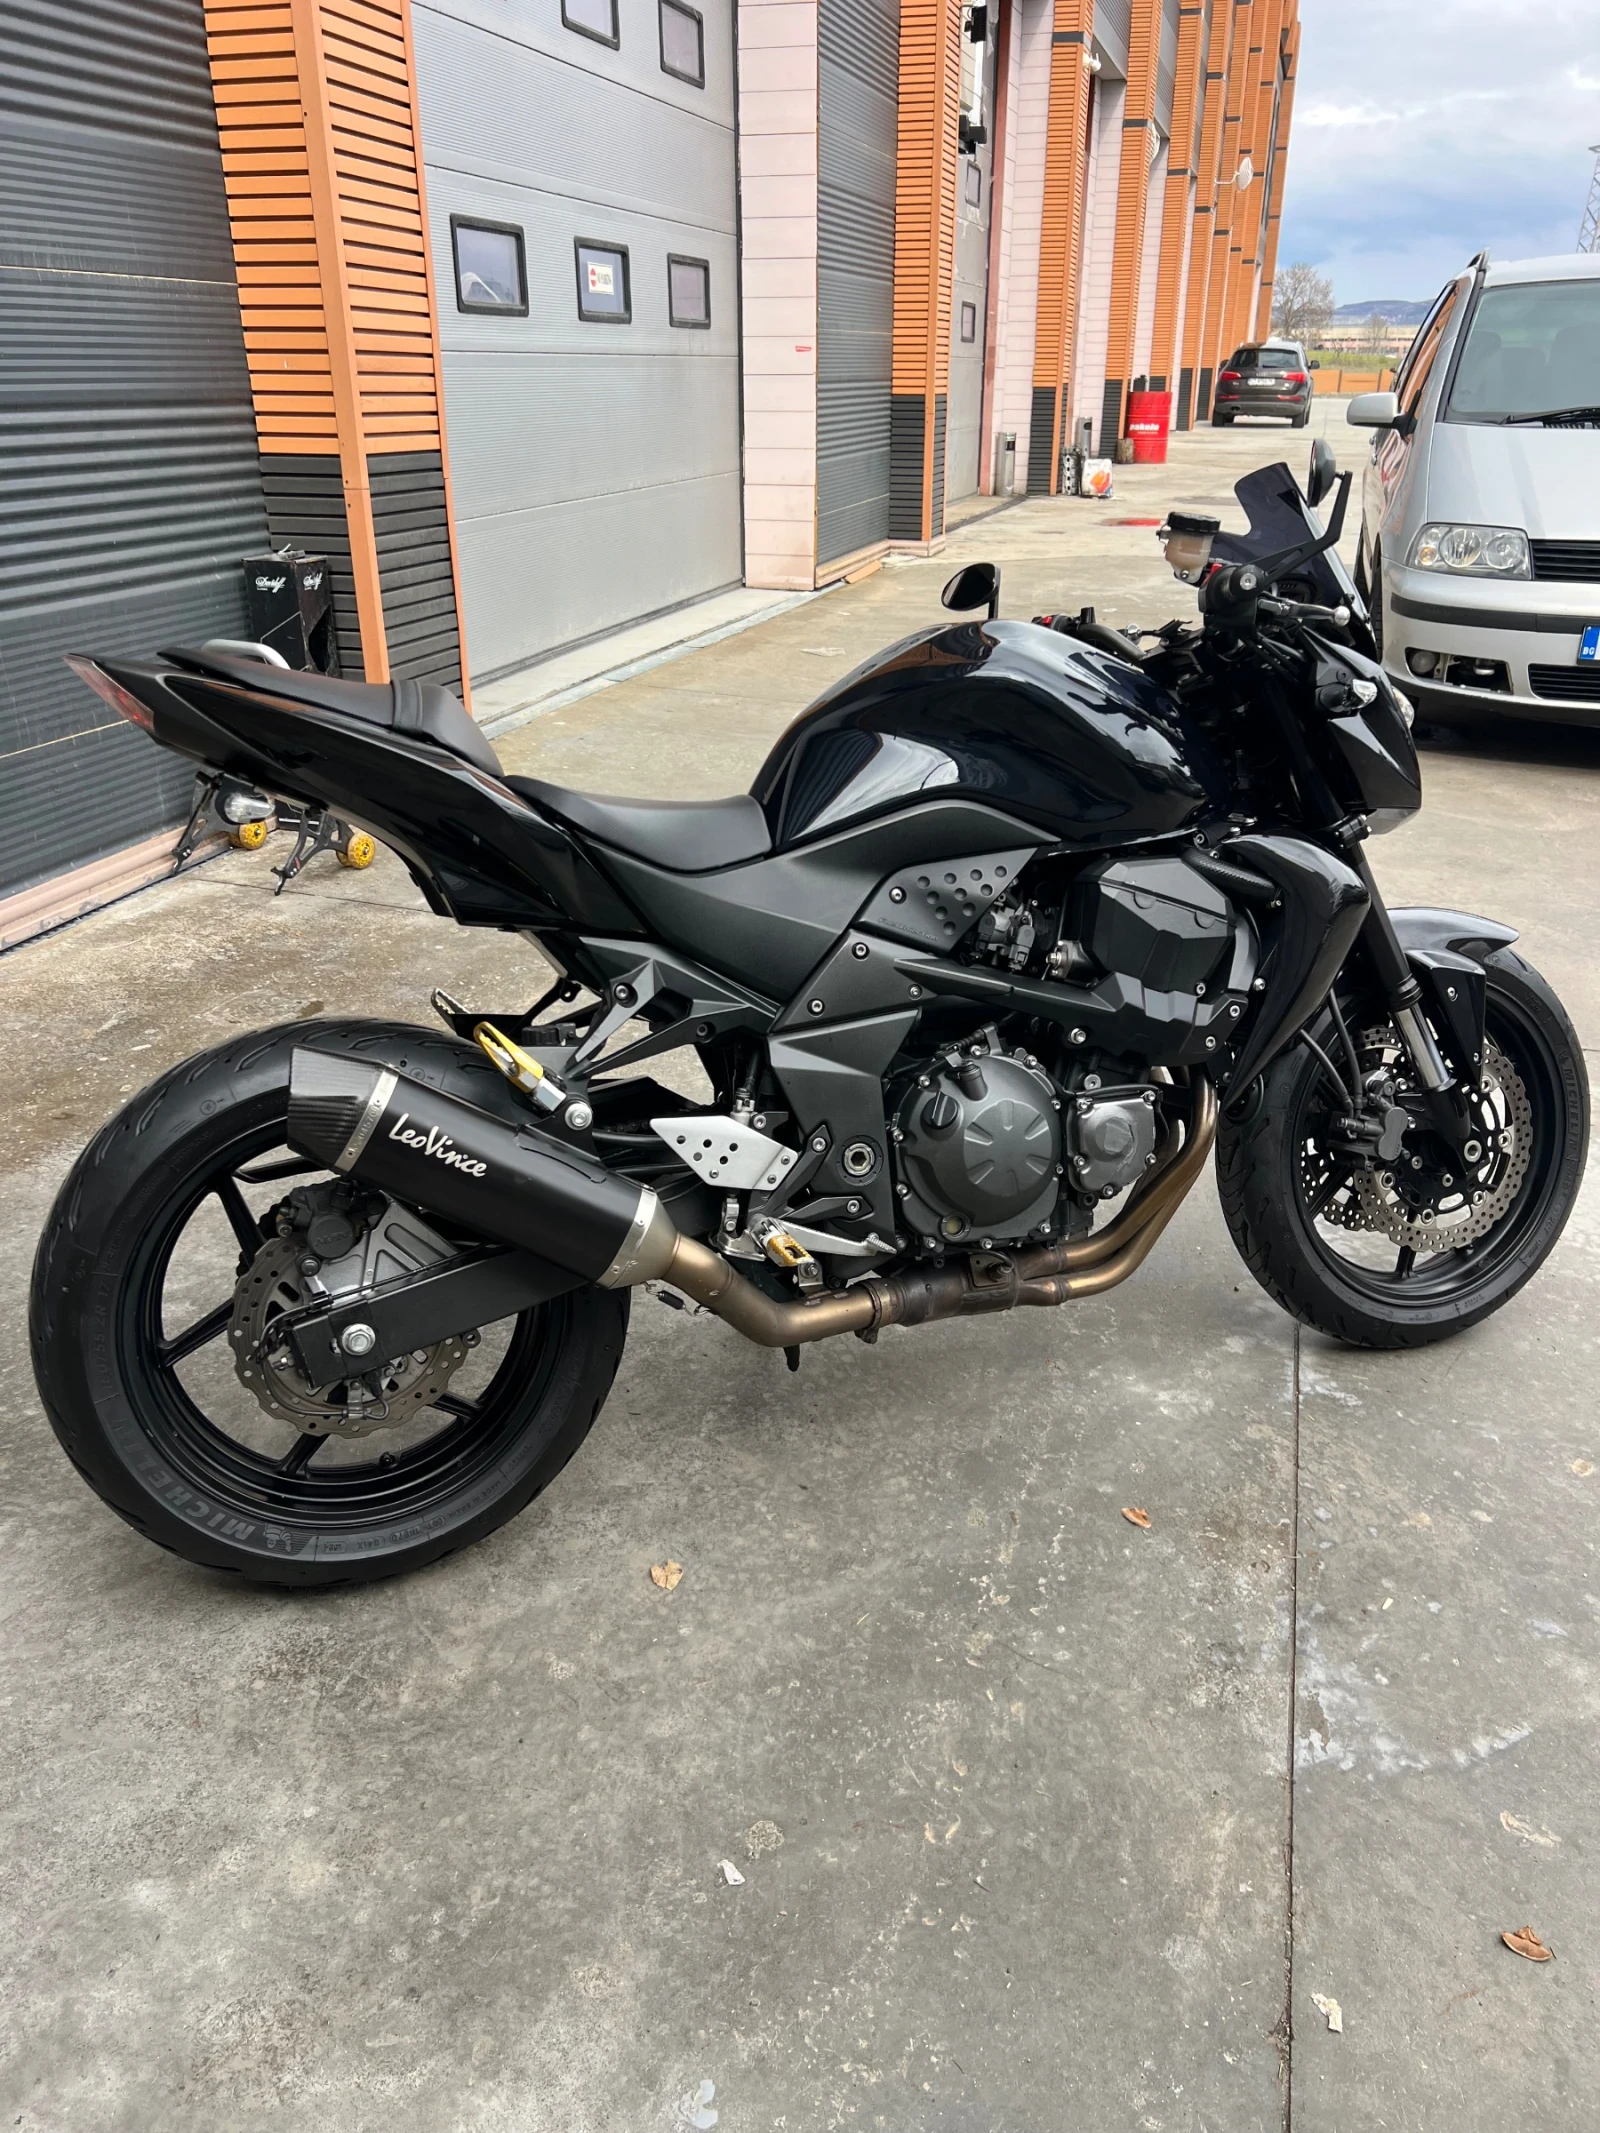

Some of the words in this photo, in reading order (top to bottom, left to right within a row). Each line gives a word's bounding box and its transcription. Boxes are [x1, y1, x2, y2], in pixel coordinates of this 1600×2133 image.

[1582, 646, 1595, 656] BG
[1563, 1067, 1579, 1147] MICHELIN
[388, 1112, 487, 1177] LeoVince
[111, 1417, 256, 1542] MICHELIN
